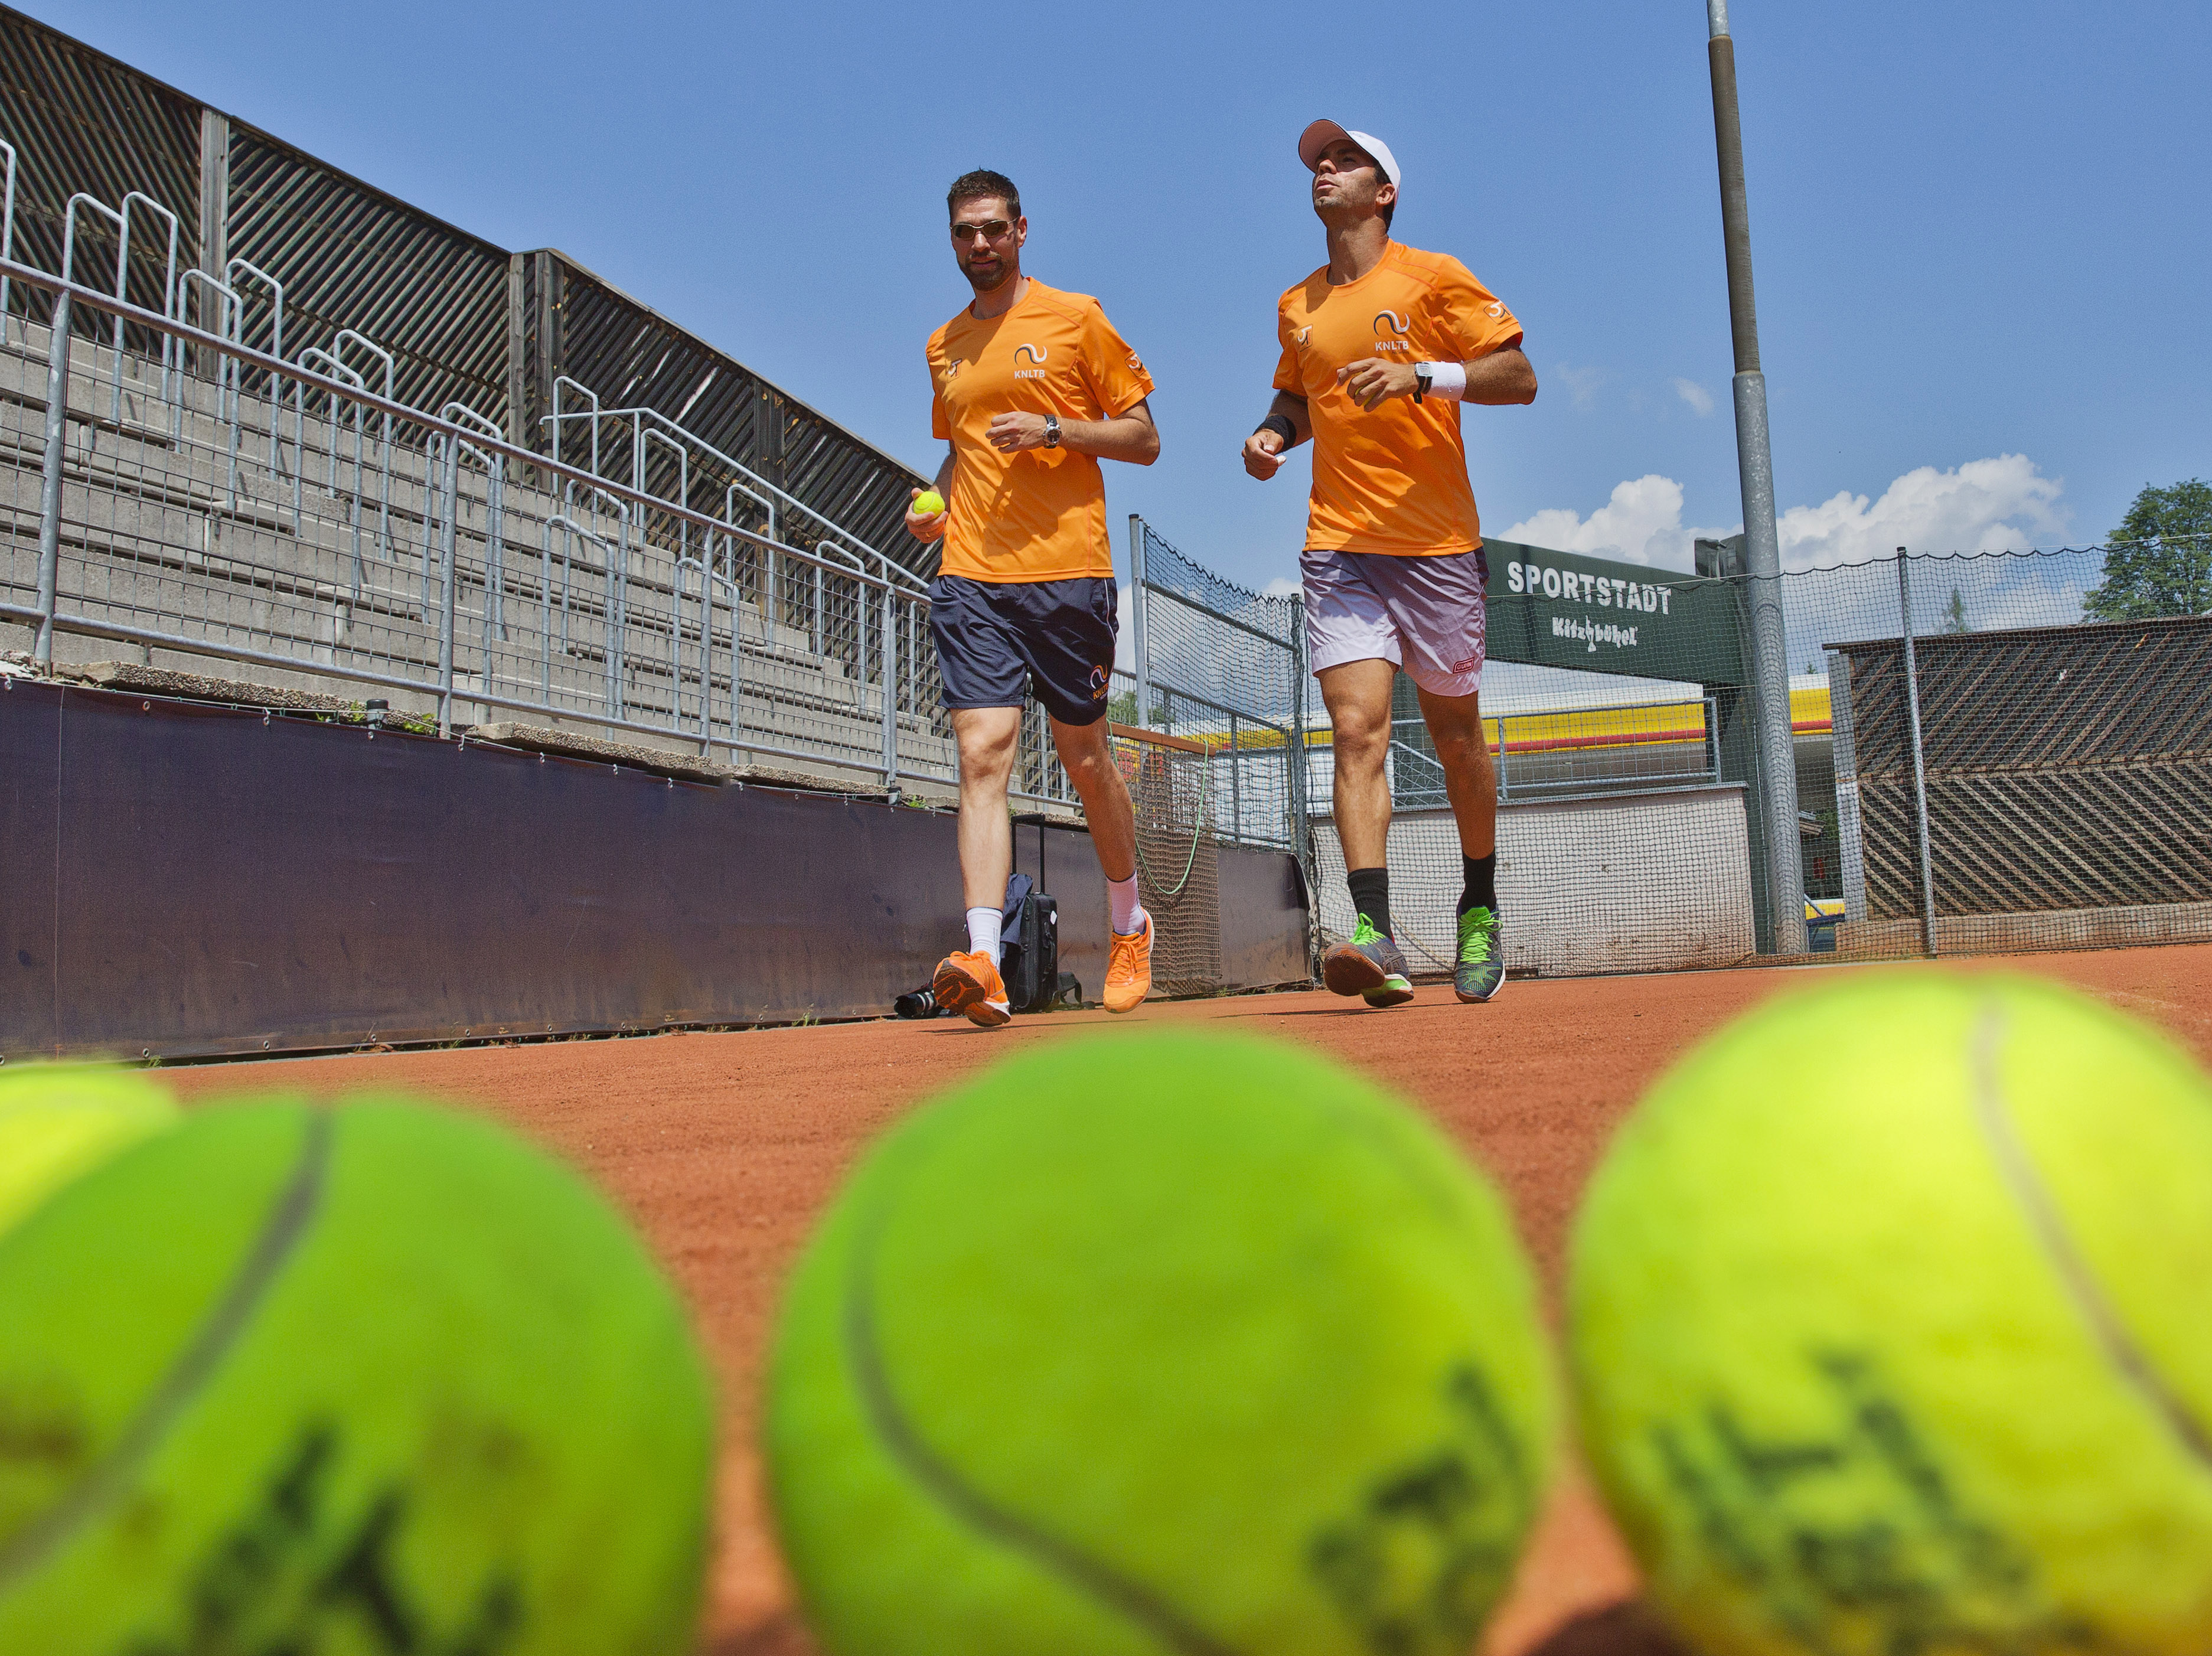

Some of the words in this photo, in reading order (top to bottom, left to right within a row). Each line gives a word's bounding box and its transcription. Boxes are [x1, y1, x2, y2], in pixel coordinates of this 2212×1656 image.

[1375, 340, 1409, 351] KNLTB
[1014, 369, 1045, 379] KNLTB
[1508, 561, 1672, 615] SPORTSTADT
